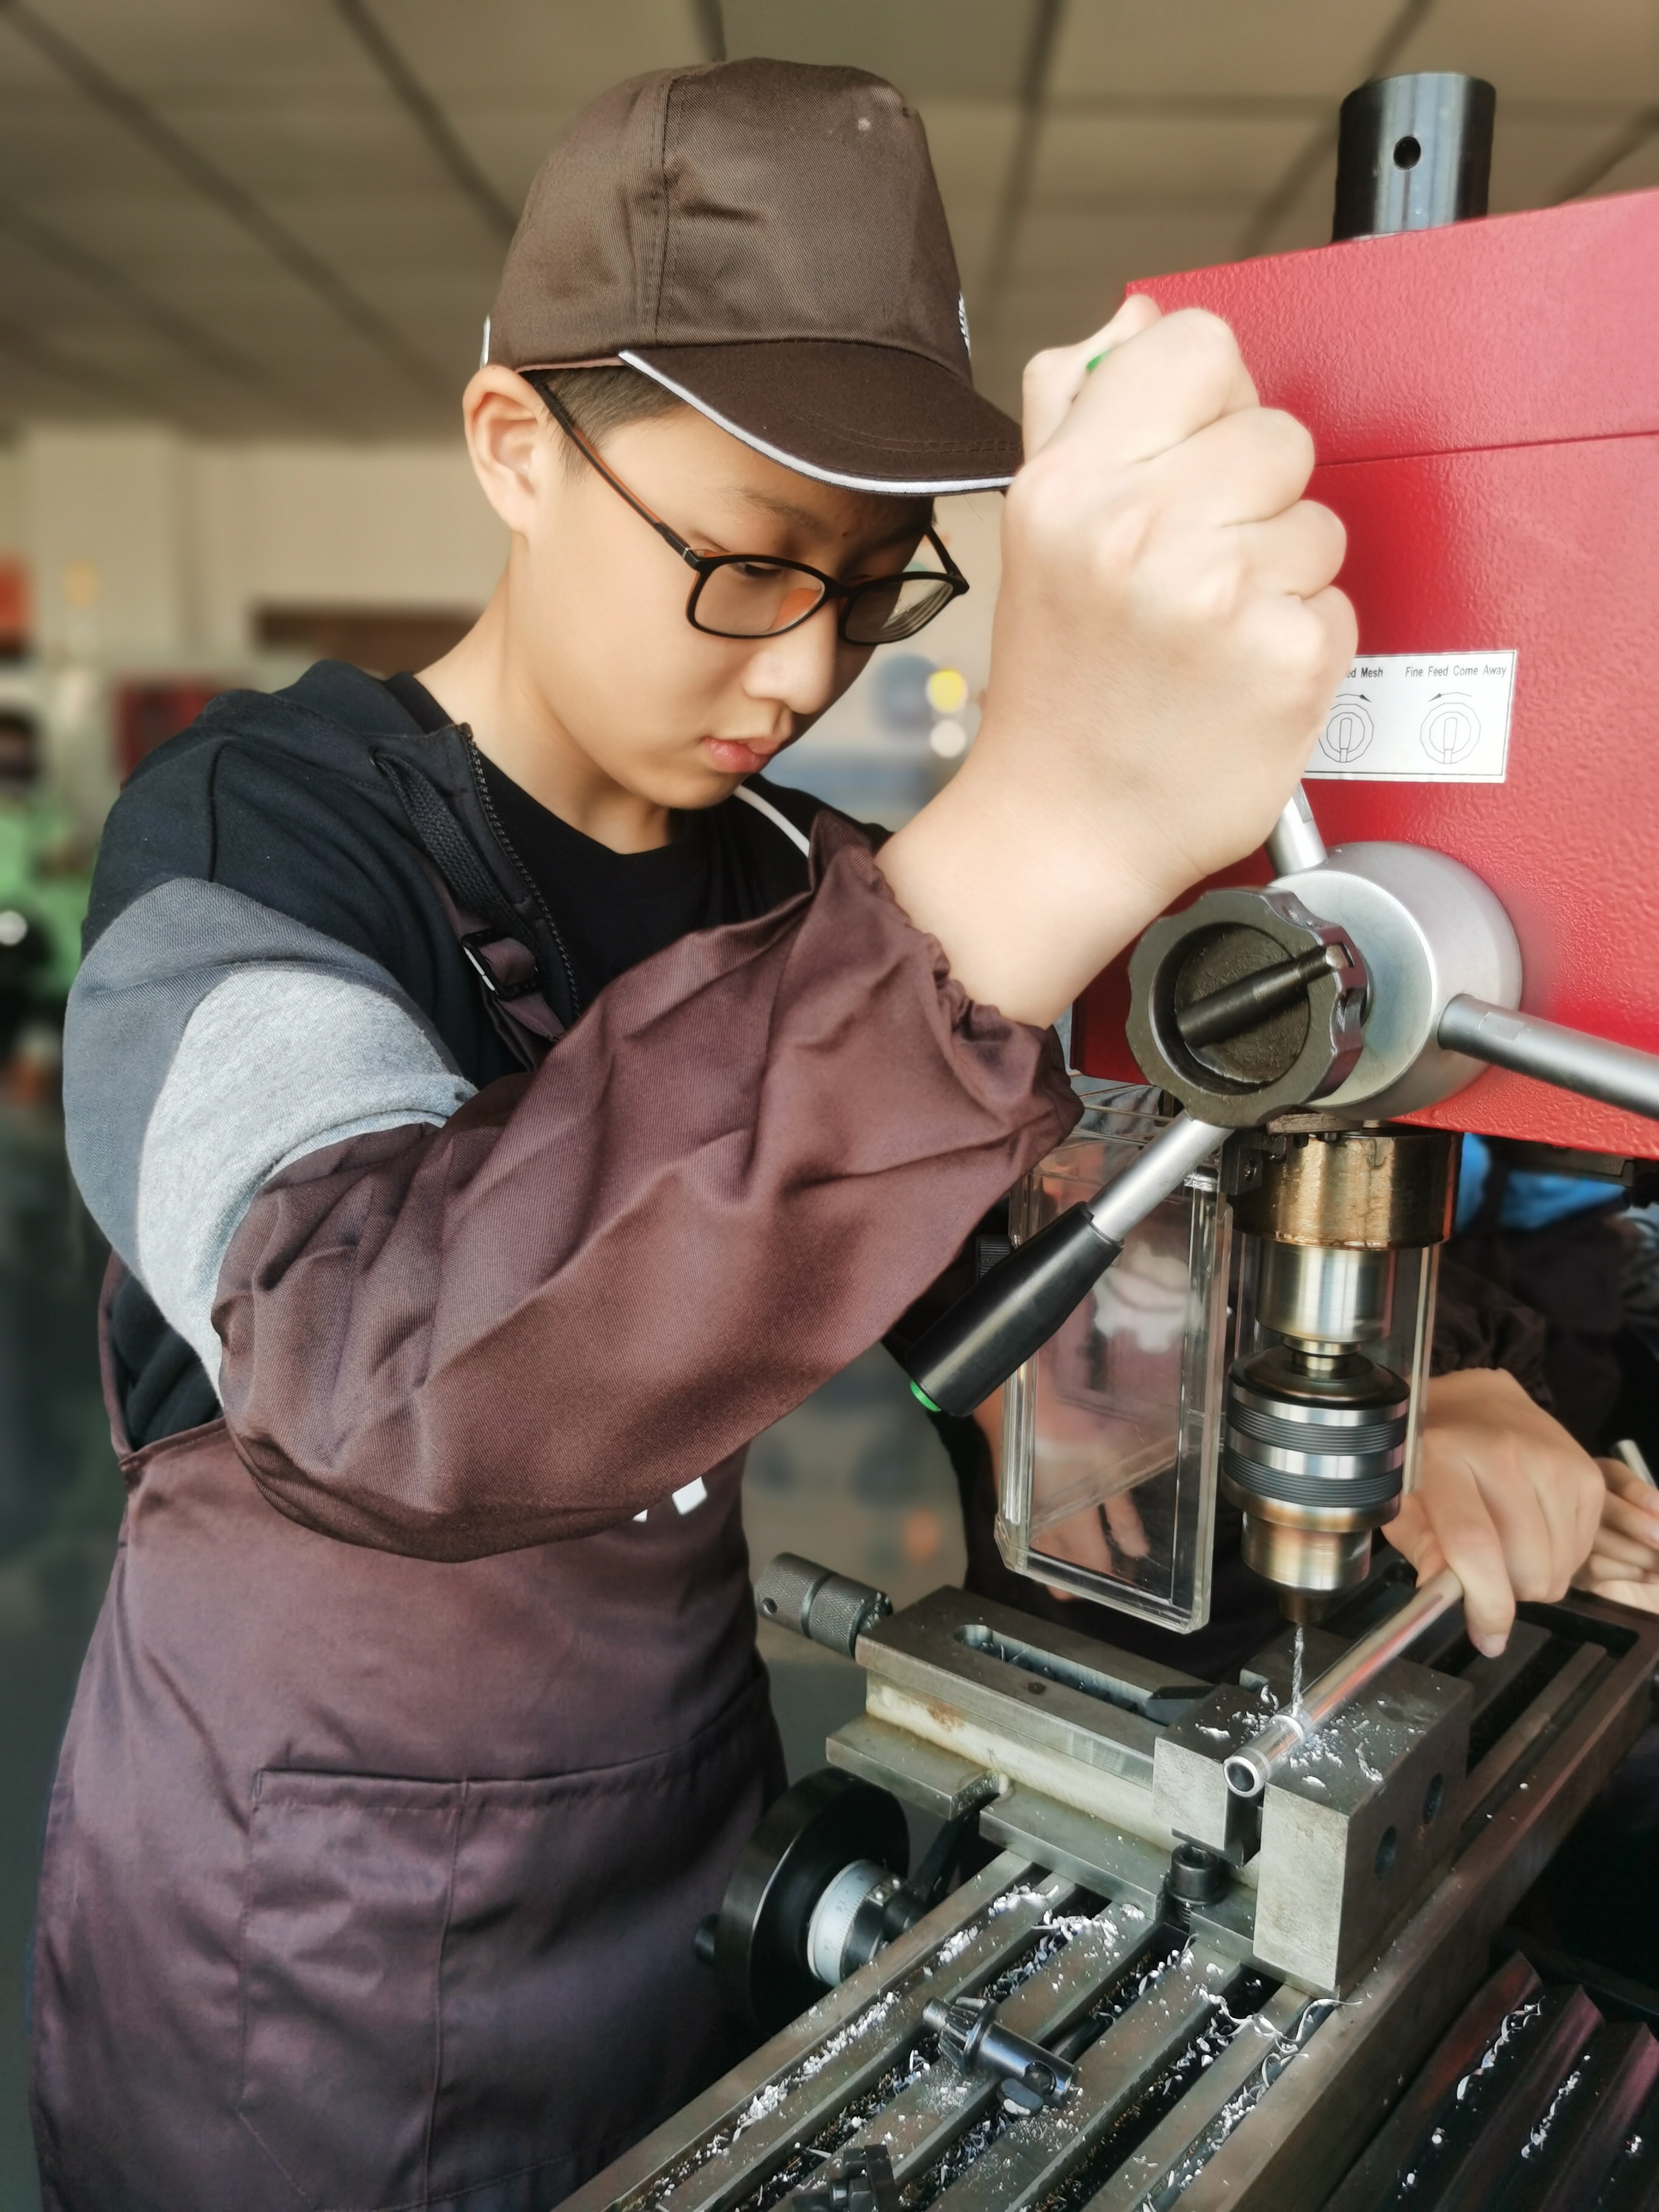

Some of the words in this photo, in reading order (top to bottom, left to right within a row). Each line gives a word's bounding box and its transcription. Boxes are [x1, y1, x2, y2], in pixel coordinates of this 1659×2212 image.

[1361, 666, 1383, 678] Mesh
[1405, 666, 1423, 677] Fine
[1427, 666, 1449, 677] Feed
[1453, 665, 1478, 676] Come
[1483, 665, 1507, 678] Away
